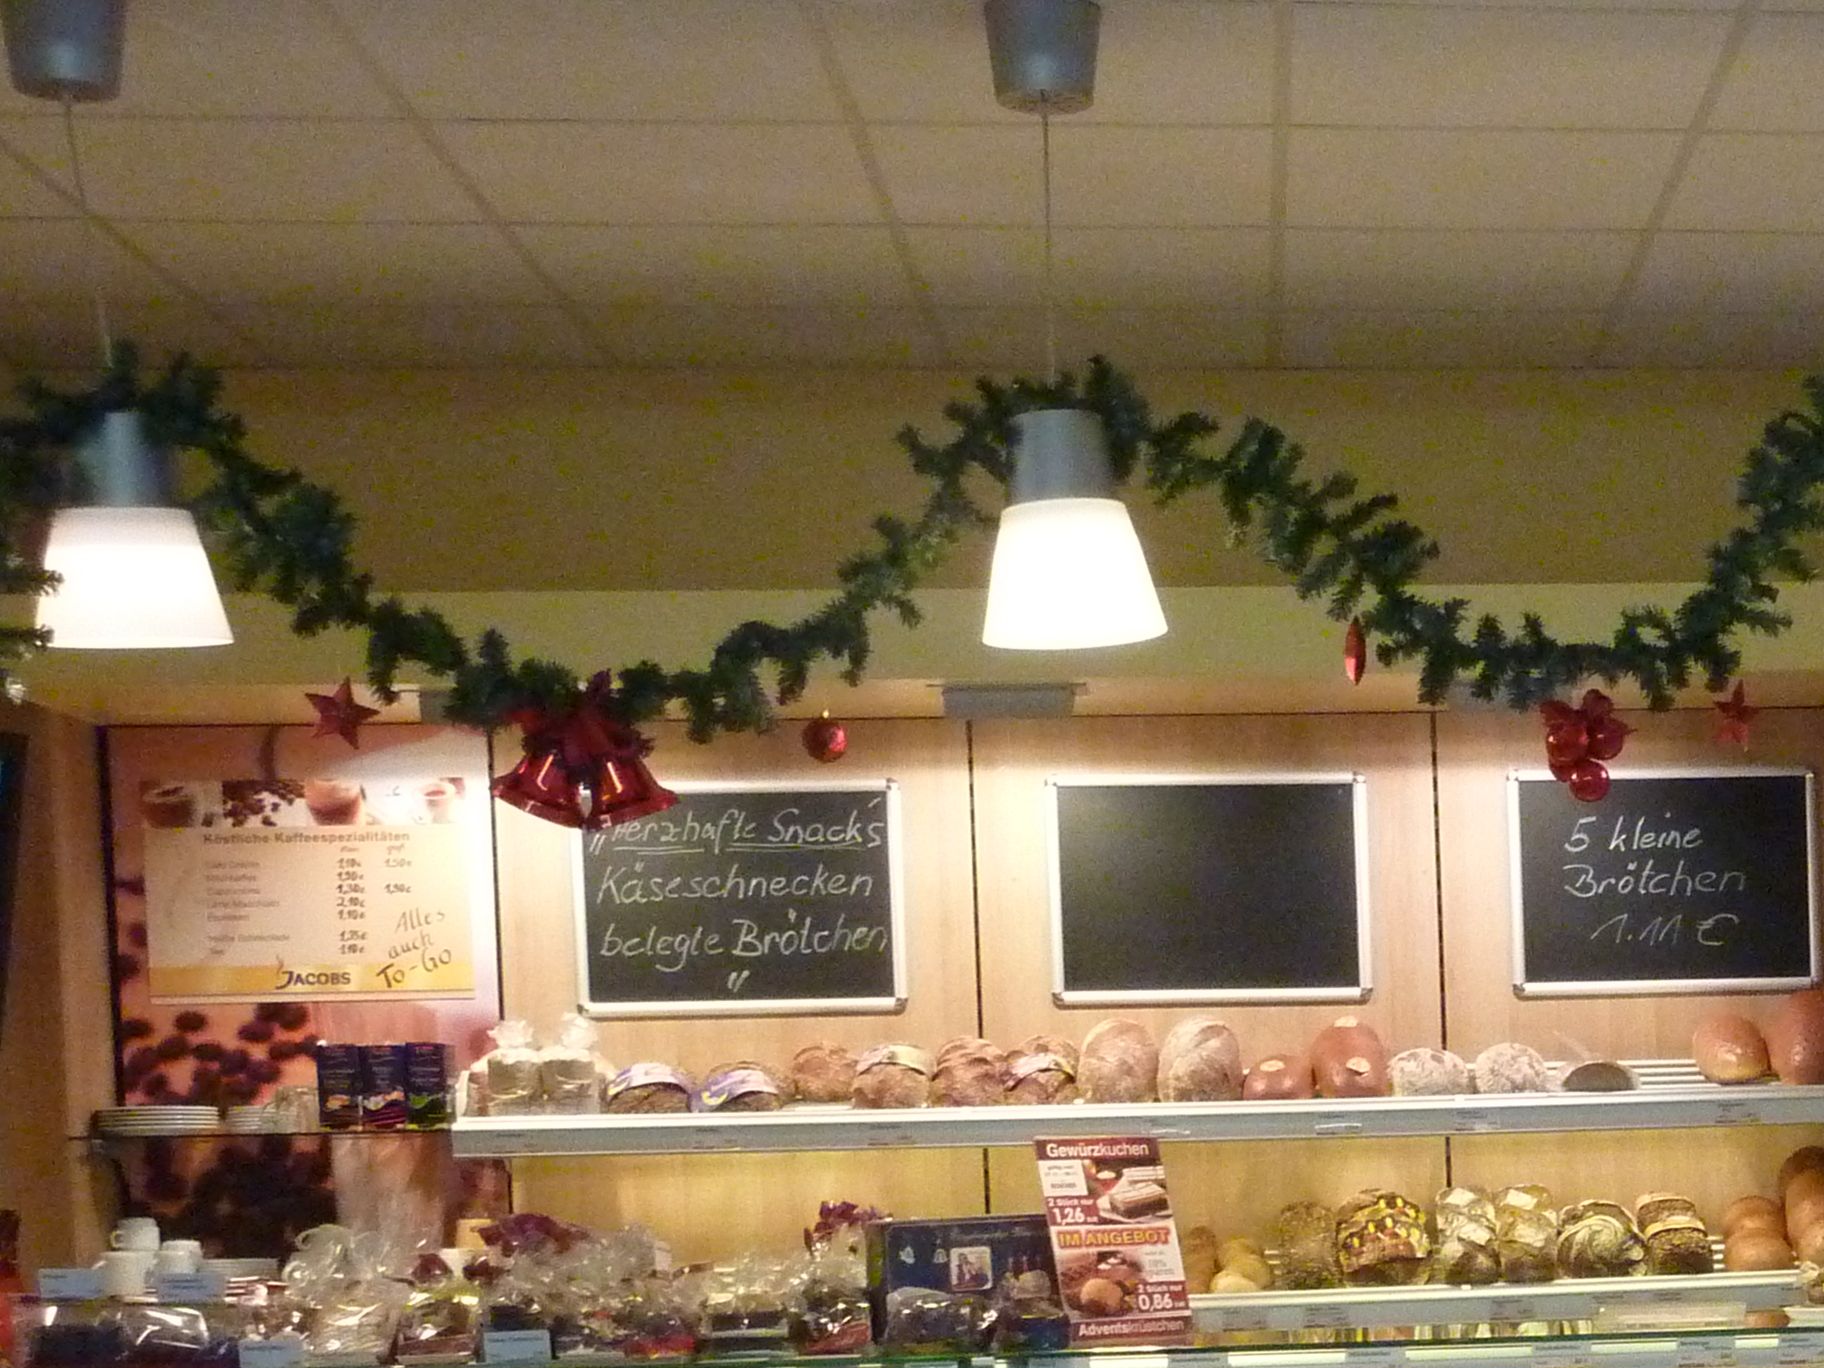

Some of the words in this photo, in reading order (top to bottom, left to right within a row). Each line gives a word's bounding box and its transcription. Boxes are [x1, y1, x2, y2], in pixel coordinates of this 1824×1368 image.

[1564, 815, 1597, 852] 5
[1608, 811, 1704, 852] kleine
[596, 861, 873, 905] Käseschnecken
[1562, 858, 1747, 898] Brötchen
[394, 907, 446, 934] Alles
[1696, 913, 1741, 947] €
[388, 931, 436, 959] auch
[601, 923, 726, 973] belegte
[731, 908, 888, 958] Brötchen
[275, 970, 351, 990] JACOBS
[1046, 1141, 1149, 1158] Gewürzkuchen
[1052, 1207, 1086, 1226] 1,26
[1058, 1233, 1081, 1248] IM
[1084, 1229, 1170, 1245] ANGEBOT
[1138, 1293, 1173, 1312] 0,86
